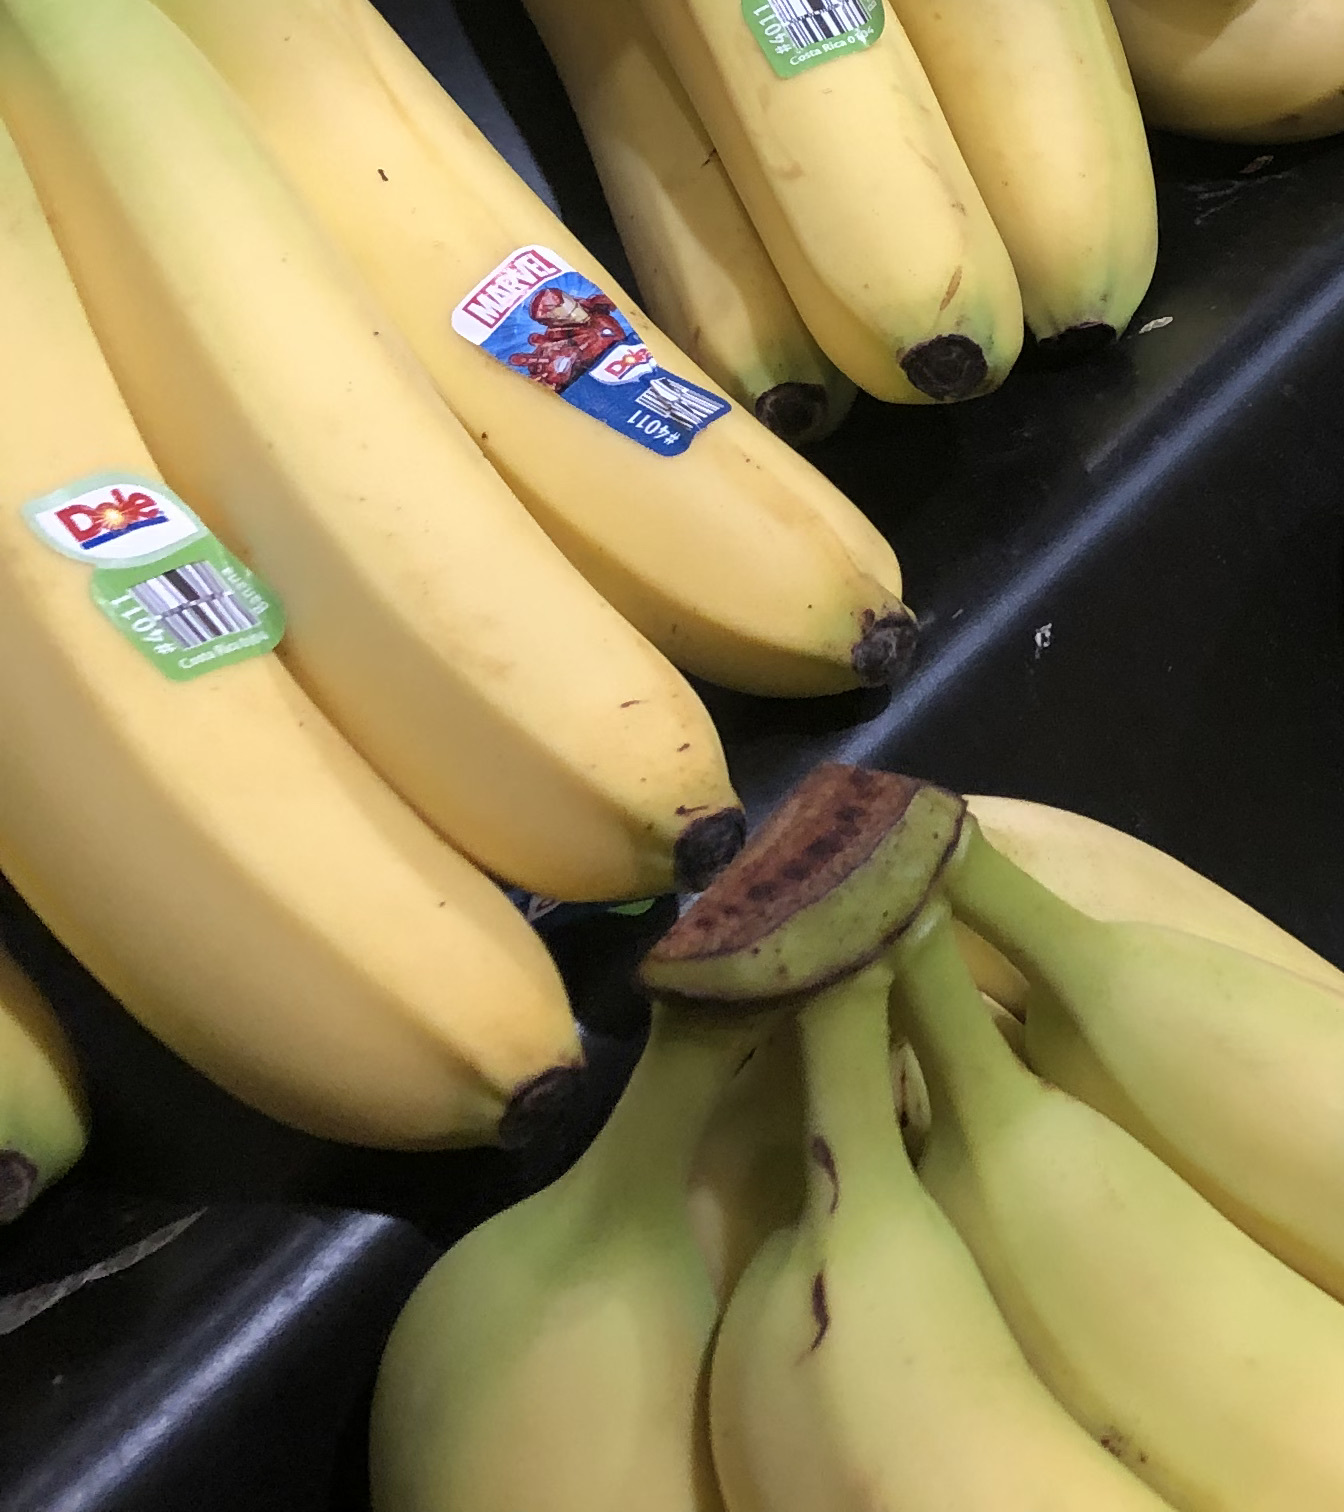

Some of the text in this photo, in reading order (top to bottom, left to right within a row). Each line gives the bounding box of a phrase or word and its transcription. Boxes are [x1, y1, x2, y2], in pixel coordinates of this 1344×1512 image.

[753, 4, 792, 55] #4011
[789, 47, 823, 65] Costa
[822, 38, 847, 53] Rica
[467, 252, 558, 325] MARVEL
[627, 409, 680, 445] #4011
[55, 488, 159, 542] Dole
[109, 588, 178, 654] #4011
